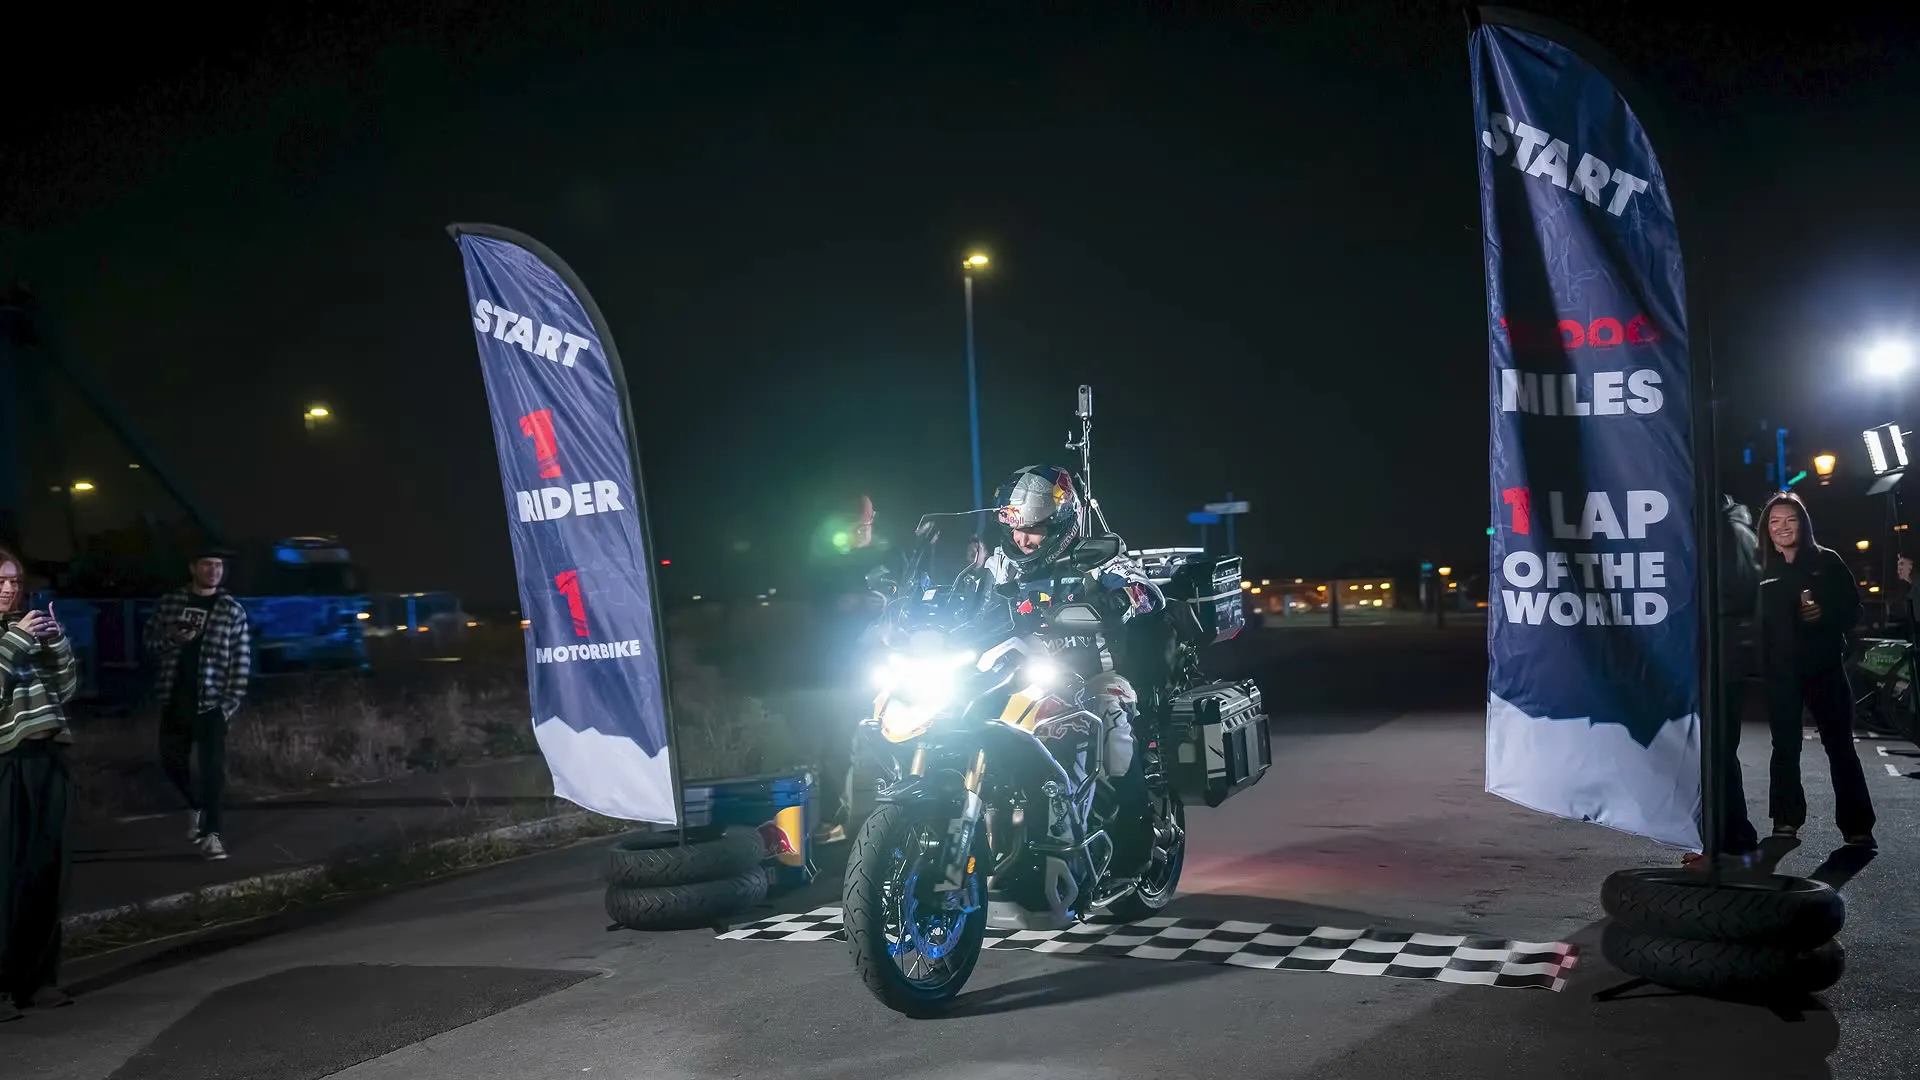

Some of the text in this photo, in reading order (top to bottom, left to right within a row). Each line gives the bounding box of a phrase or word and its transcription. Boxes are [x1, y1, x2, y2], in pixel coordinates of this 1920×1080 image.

[1482, 112, 1648, 217] START
[474, 299, 590, 367] START
[1502, 369, 1664, 416] MILES
[519, 409, 562, 479] 1
[517, 480, 624, 523] RIDER
[1502, 486, 1669, 539] 1 LAP
[1502, 551, 1666, 589] OF THE
[554, 569, 590, 637] 1
[1502, 590, 1669, 626] WORLD
[536, 639, 641, 664] MOTORBIKE
